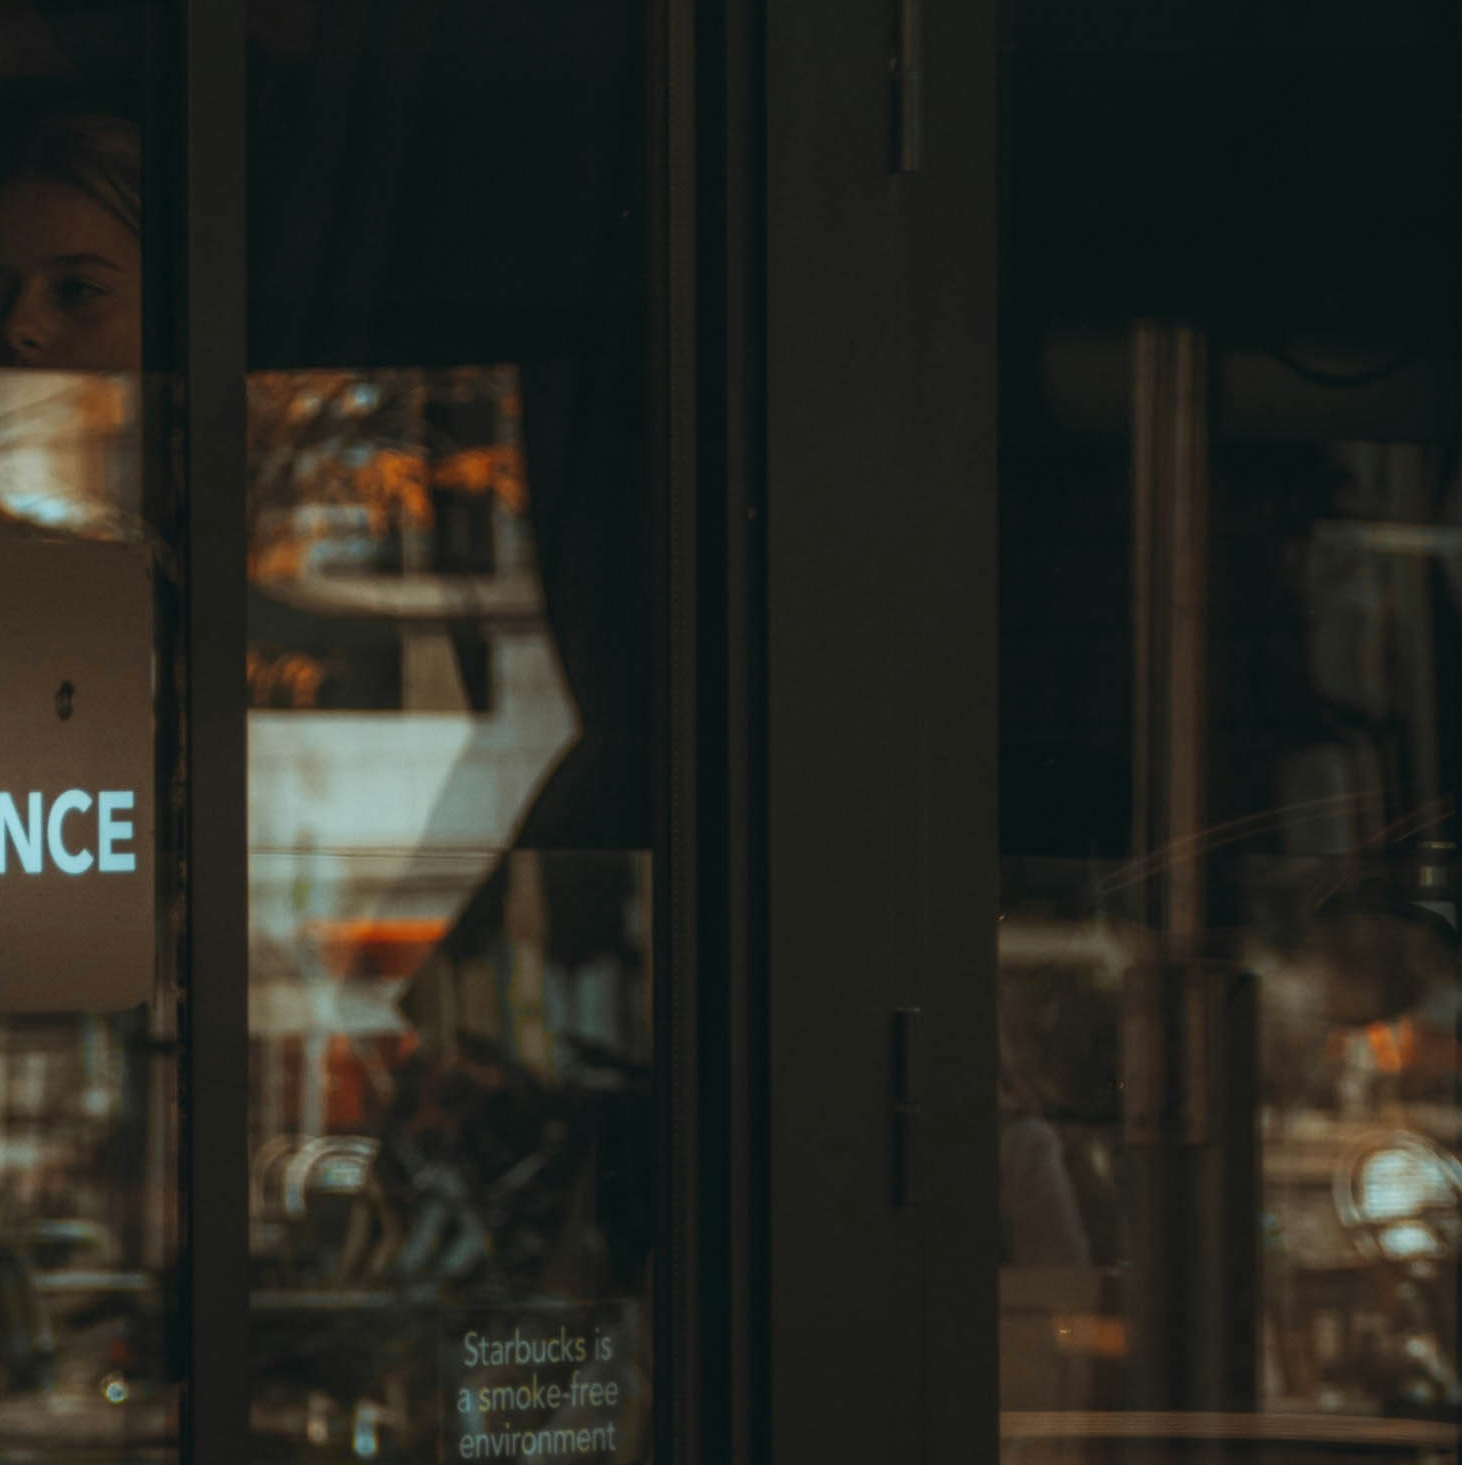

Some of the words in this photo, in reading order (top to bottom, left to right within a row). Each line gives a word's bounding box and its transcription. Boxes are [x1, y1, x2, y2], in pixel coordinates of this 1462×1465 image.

[463, 1324, 587, 1368] Starbucks
[594, 1326, 613, 1362] is
[457, 1386, 471, 1413] a
[478, 1369, 619, 1413] smoke-free
[459, 1421, 617, 1459] environment
